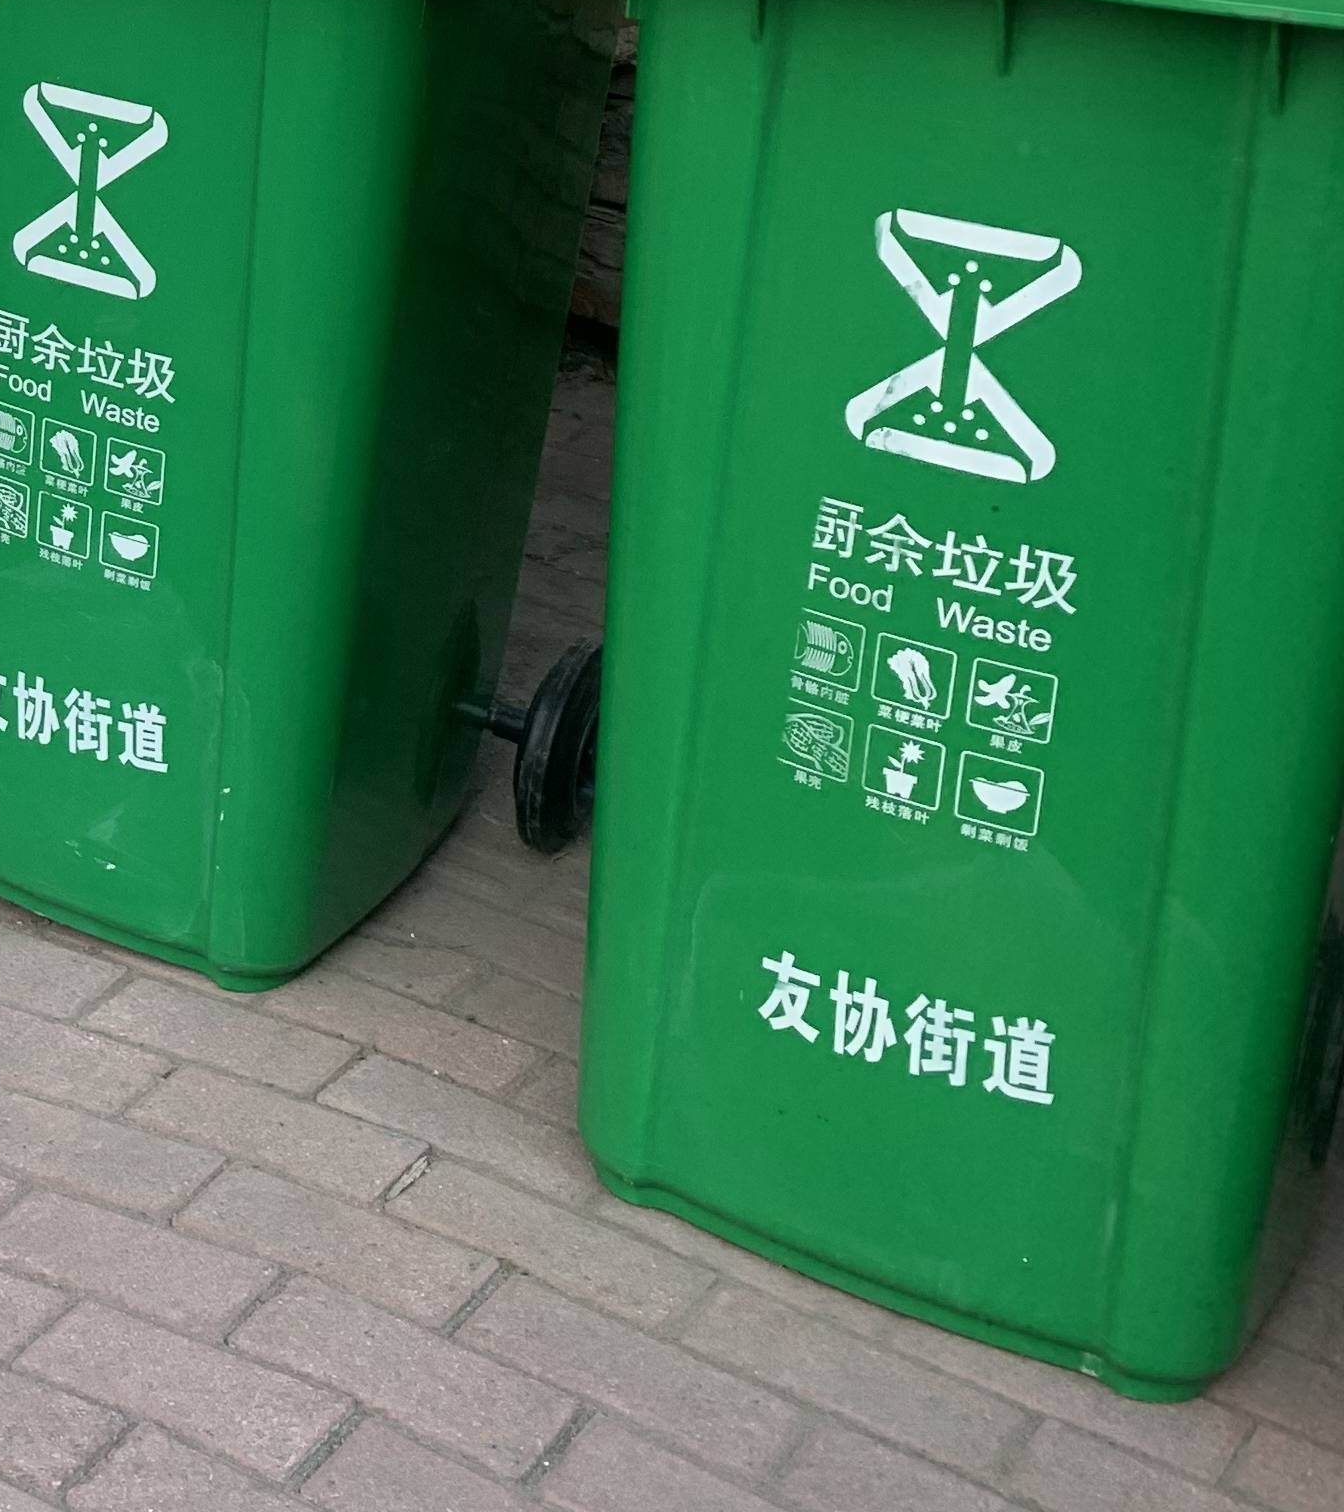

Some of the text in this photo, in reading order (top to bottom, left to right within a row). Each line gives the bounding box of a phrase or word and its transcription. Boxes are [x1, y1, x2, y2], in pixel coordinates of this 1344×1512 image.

[81, 389, 161, 433] Waste
[812, 496, 1078, 615] 厨余垃圾
[807, 562, 1052, 652] Food Waste
[877, 704, 942, 733] 菜梗菜叶
[990, 735, 1022, 754] 果皮
[865, 795, 930, 825] 残枝落叶
[759, 951, 1055, 1105] 友协街道
